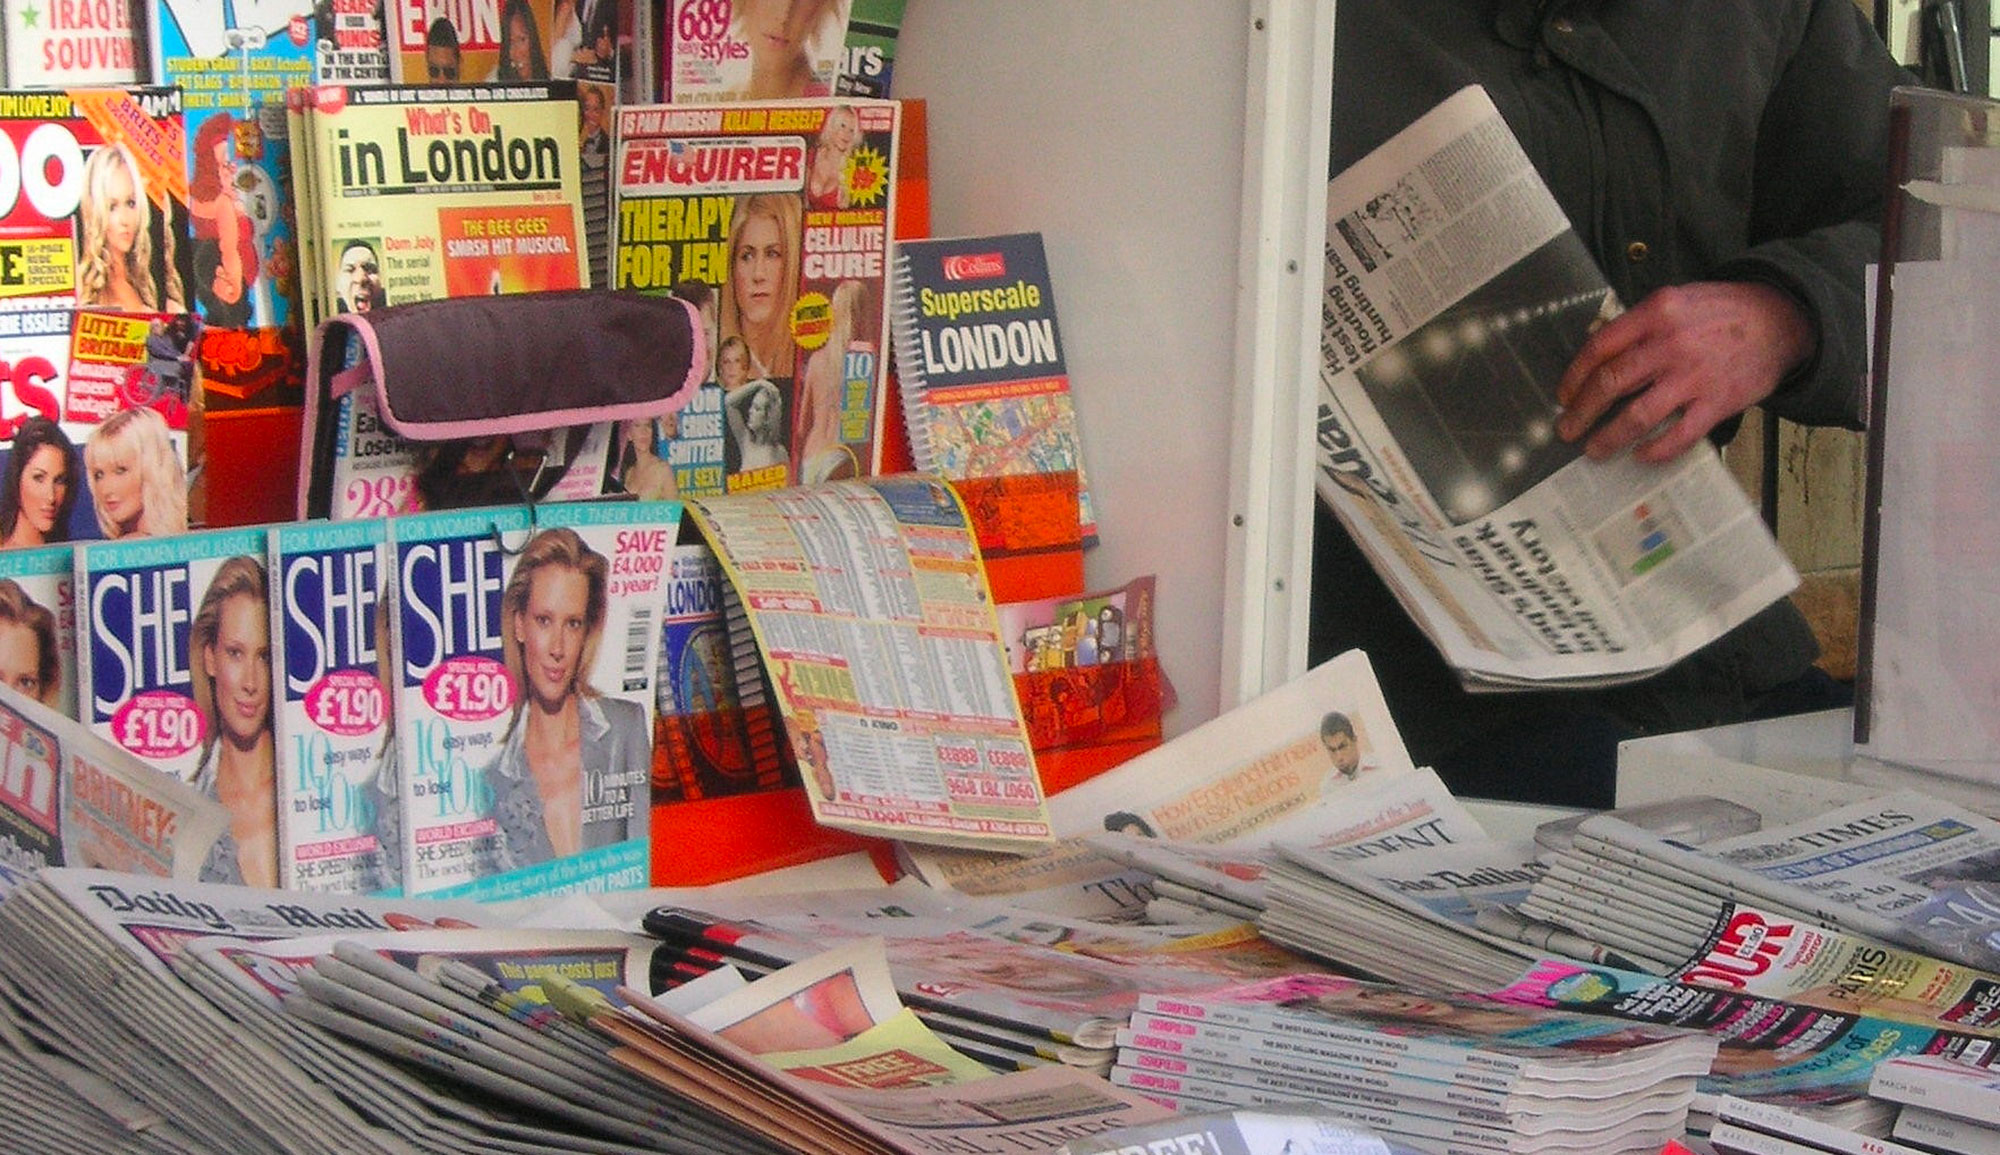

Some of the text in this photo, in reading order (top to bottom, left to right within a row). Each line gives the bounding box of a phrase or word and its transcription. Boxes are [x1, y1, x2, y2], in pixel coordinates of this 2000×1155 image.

[678, 0, 732, 42] 689
[700, 35, 749, 64] styles
[121, 98, 164, 146] BRITS
[405, 107, 492, 136] What's On
[338, 124, 561, 186] in London
[622, 147, 803, 187] ENQUIRER
[462, 218, 511, 236] THE BEE
[621, 197, 735, 242] THERAPY
[447, 236, 570, 258] SMASH HIT MUSICAL
[387, 257, 430, 270] The serial
[618, 242, 728, 289] FOR JEN
[804, 252, 882, 279] CURE
[956, 255, 1002, 276] Collins
[388, 274, 430, 288] prankster
[920, 280, 1041, 320] Superscale
[1343, 272, 1393, 346] hunting
[80, 314, 130, 339] LITTLE
[921, 318, 1058, 375] LONDON
[727, 465, 787, 490] NAKED
[616, 530, 667, 554] SAVE
[613, 556, 663, 575] £4,000
[611, 577, 659, 597] a year!
[668, 578, 717, 615] LONDO
[285, 551, 378, 693] SHE
[403, 540, 503, 680] SHE
[92, 568, 191, 715] SHE
[317, 686, 383, 726] £1.90
[434, 673, 509, 711] £1.90
[123, 708, 199, 749] £1.90
[443, 734, 467, 751] easy
[468, 731, 494, 748] ways
[323, 750, 347, 765] easy
[348, 747, 371, 762] ways
[413, 783, 426, 797] to
[428, 780, 452, 796] lose
[584, 769, 646, 807] 10 MINUTES
[605, 788, 628, 804] TO A
[294, 799, 307, 812] to
[581, 804, 635, 824] BETTER LIFE
[1798, 809, 1916, 848] TIMES
[88, 884, 389, 932] Daily Mail
[1783, 929, 1815, 970] Tsunami
[1799, 931, 1826, 966] horror
[560, 962, 592, 979] costs
[593, 960, 618, 980] just
[1827, 947, 1888, 1000] PARIS
[1878, 1078, 1908, 1091] MARCH
[1904, 1120, 1935, 1133] MARCH
